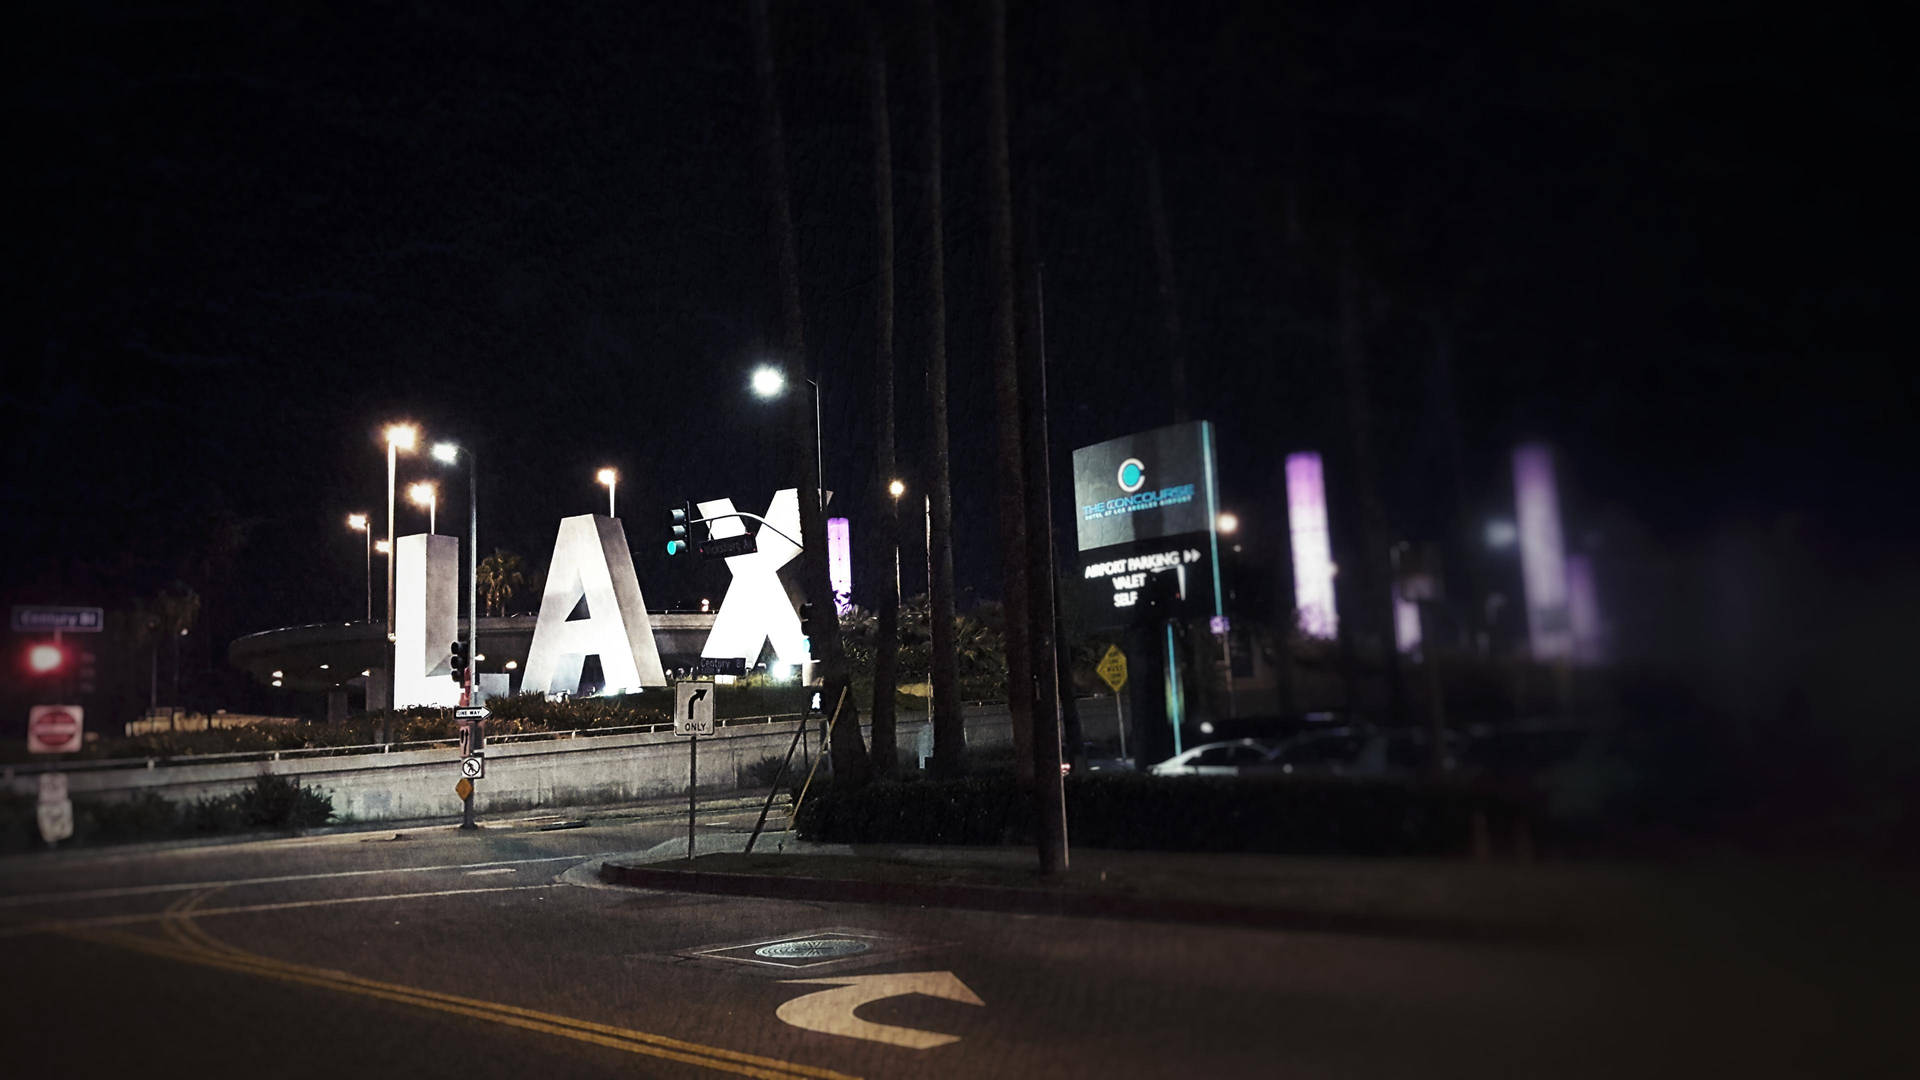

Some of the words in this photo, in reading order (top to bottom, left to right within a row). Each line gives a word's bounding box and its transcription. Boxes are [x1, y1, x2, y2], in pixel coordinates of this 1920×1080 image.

[1082, 502, 1106, 515] THE
[1106, 483, 1195, 510] CONCOURSE
[1085, 559, 1127, 579] AIRPORT
[1127, 551, 1180, 572] PARKING
[1112, 573, 1147, 590] VALET
[394, 488, 803, 711] LAX
[1113, 591, 1138, 607] SELF
[685, 722, 706, 732] ONLY
